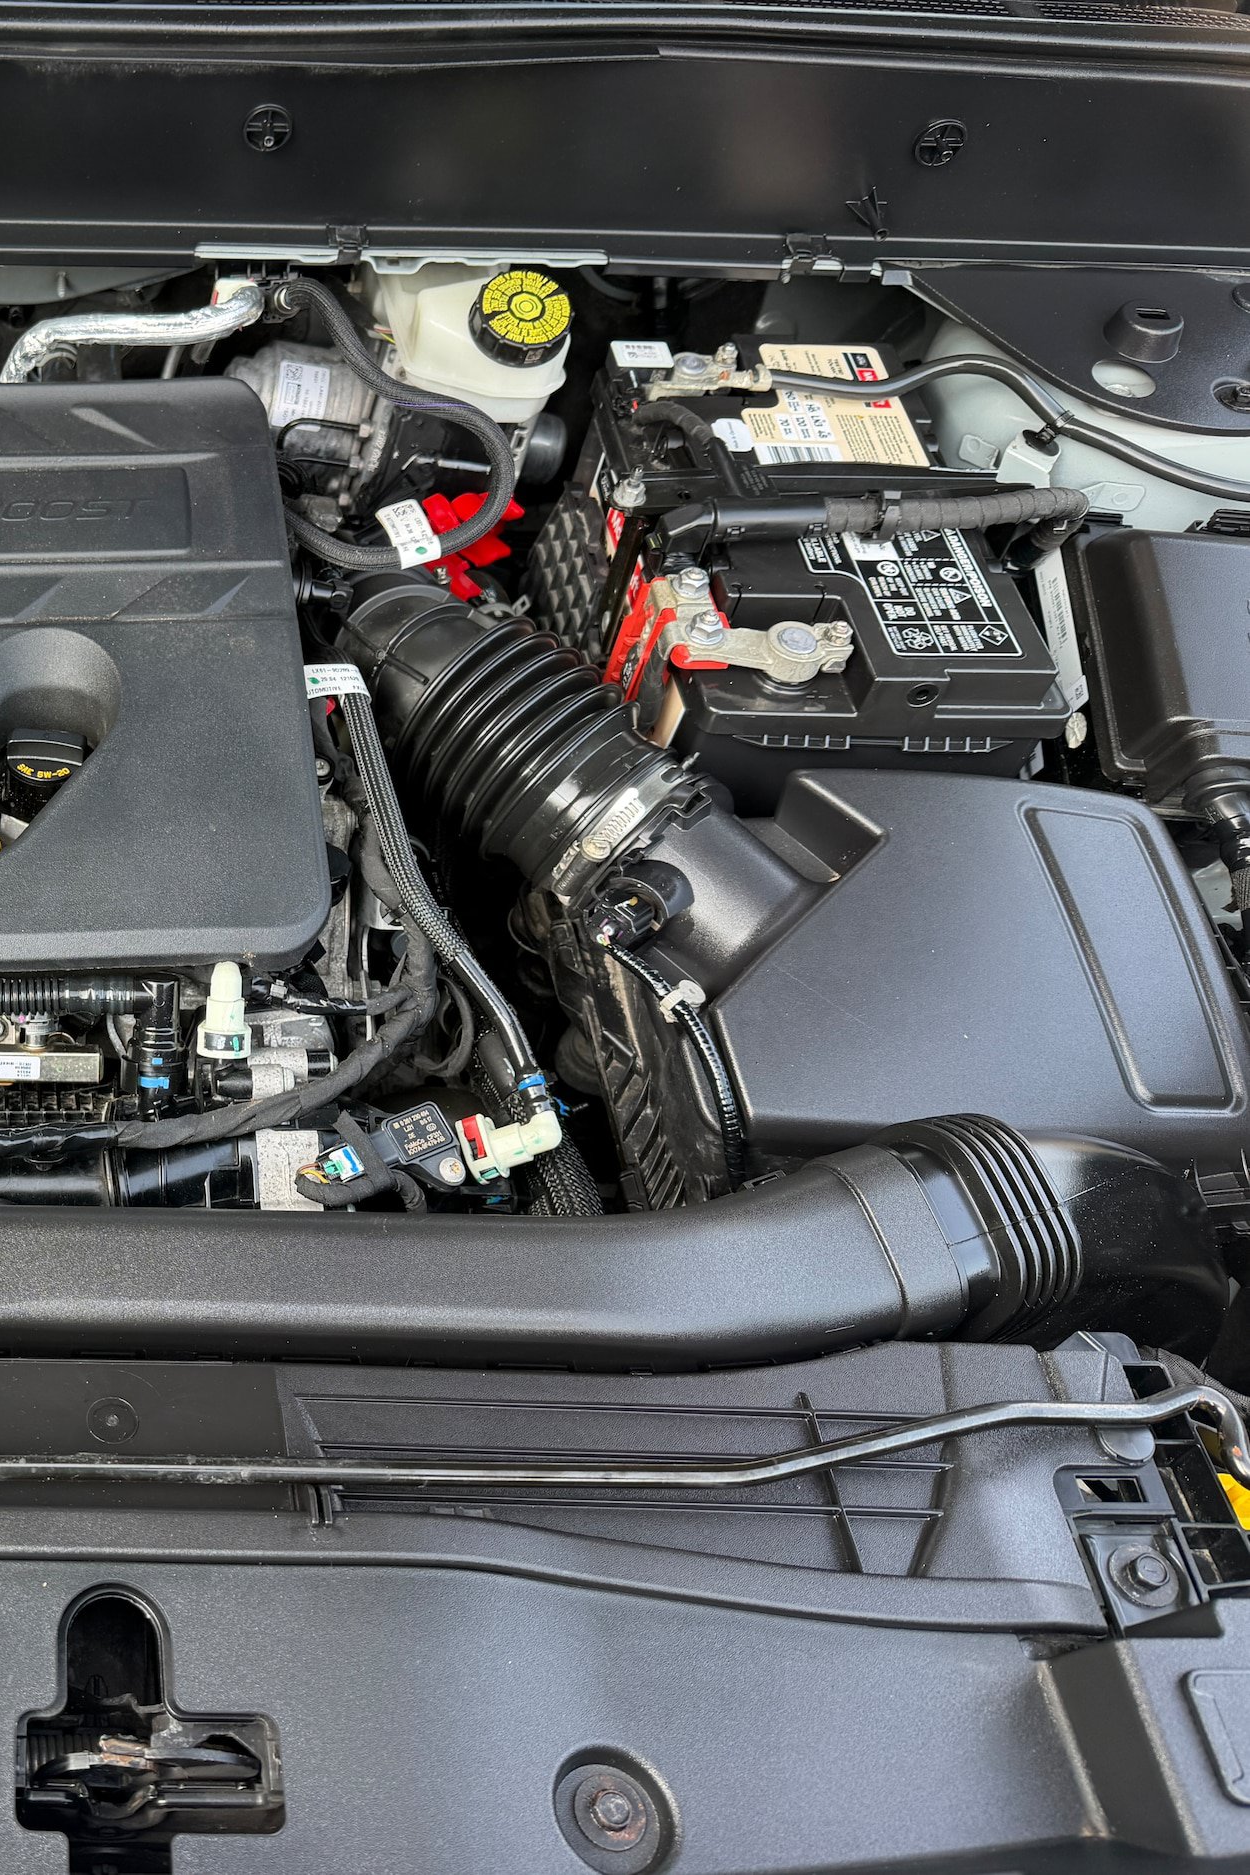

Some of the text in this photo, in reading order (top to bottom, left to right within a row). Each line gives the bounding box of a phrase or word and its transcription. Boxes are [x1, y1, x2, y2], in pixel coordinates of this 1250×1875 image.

[944, 534, 994, 607] DANGER/POISON
[891, 604, 908, 617] NOT
[16, 763, 71, 779] SAE 5W-20
